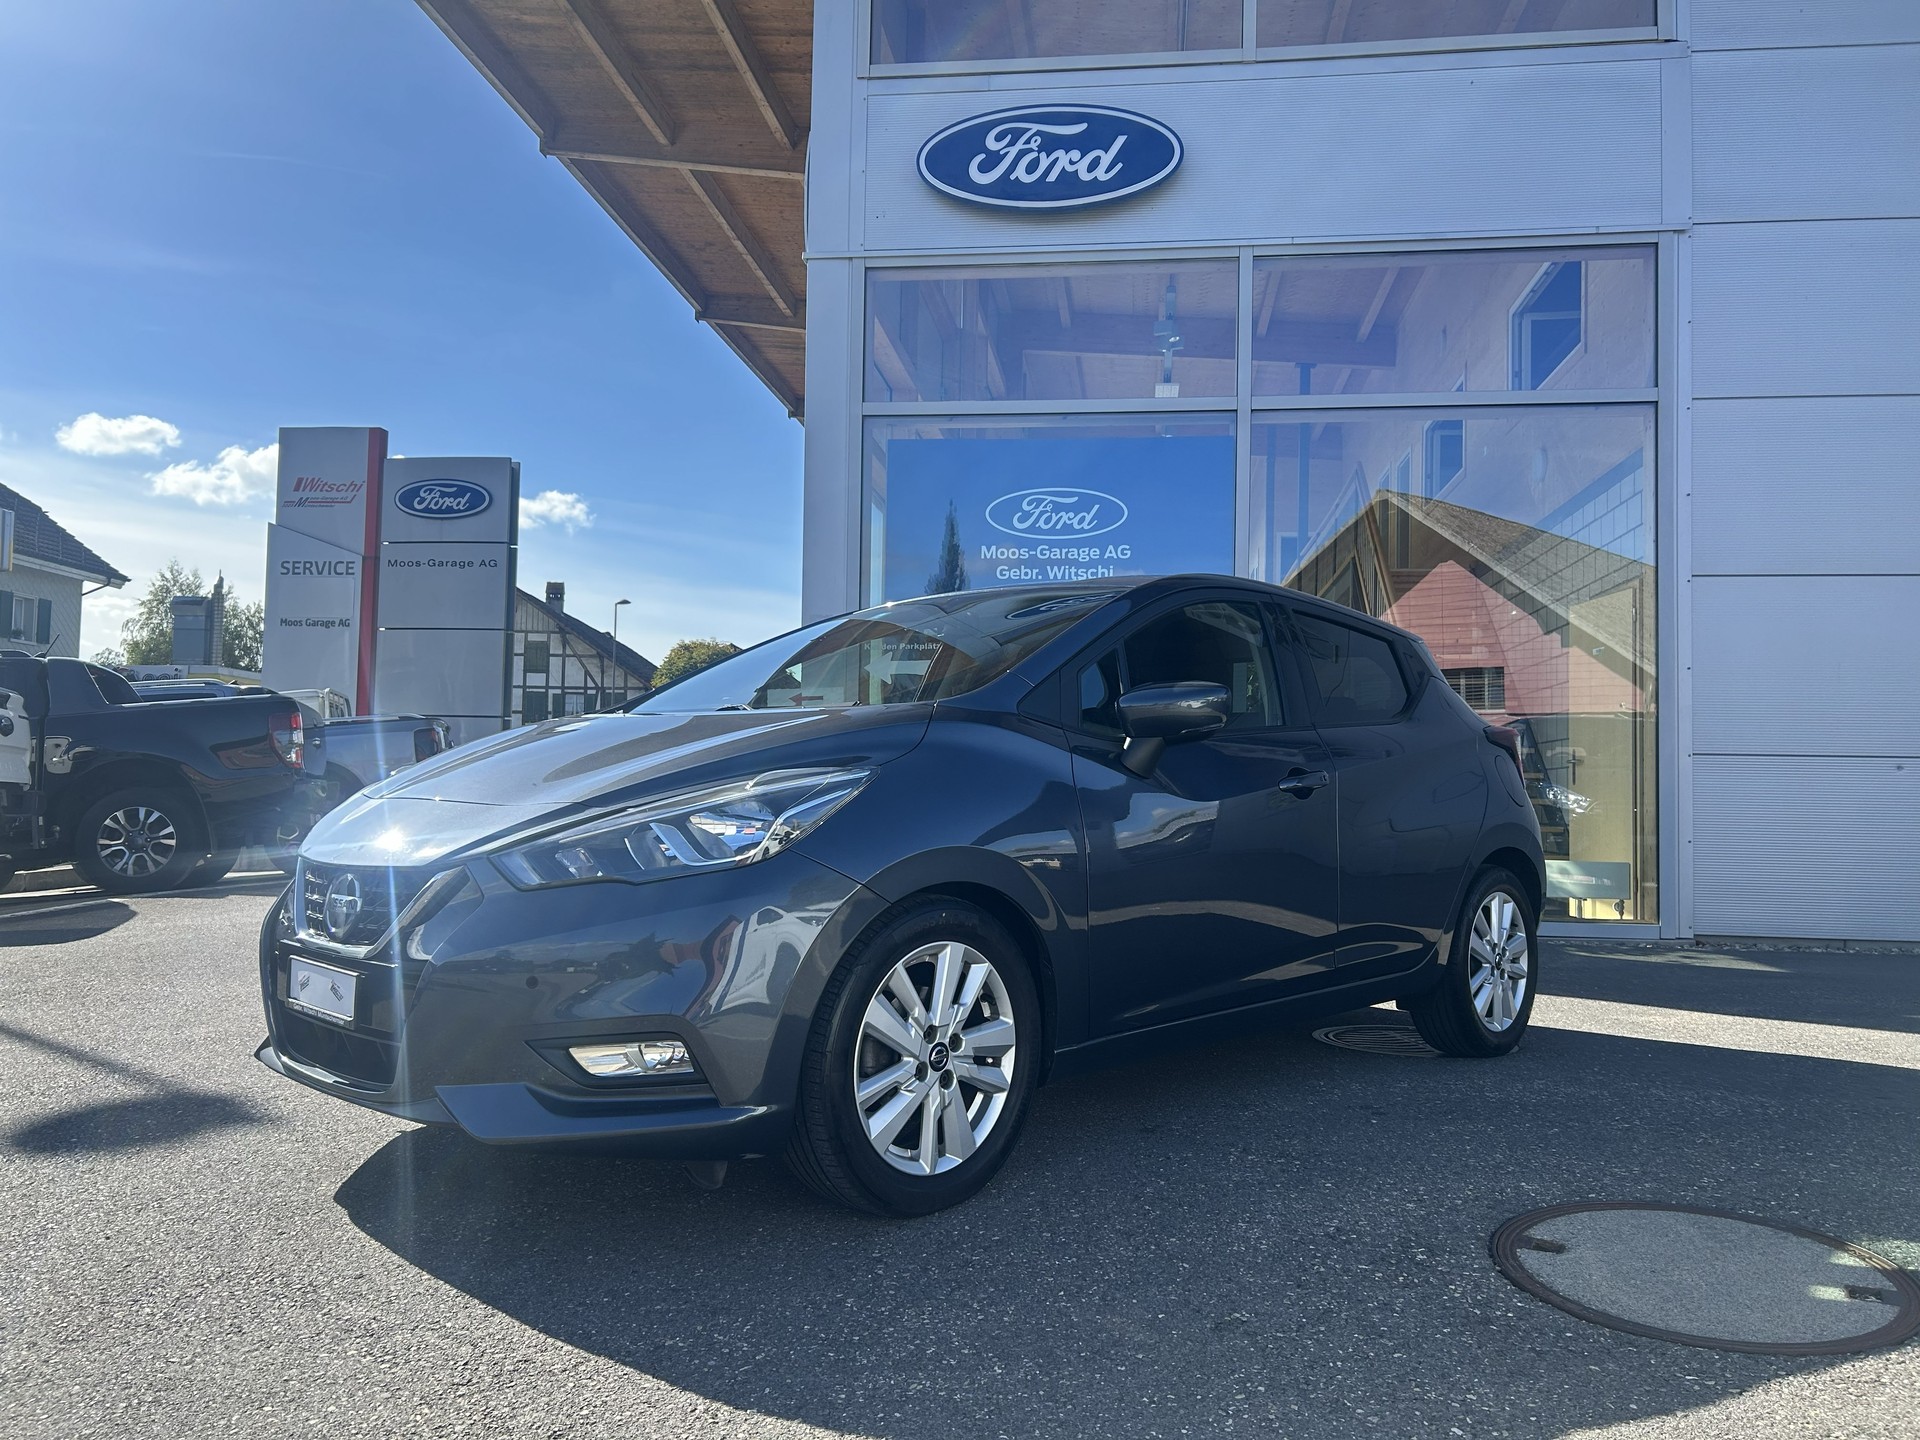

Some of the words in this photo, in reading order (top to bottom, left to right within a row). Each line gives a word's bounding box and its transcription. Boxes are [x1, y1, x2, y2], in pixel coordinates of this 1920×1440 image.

[969, 122, 1128, 184] Ford
[301, 477, 365, 492] Witschi
[414, 486, 471, 510] Ford
[1013, 495, 1100, 529] Ford
[981, 545, 1099, 561] Moos-Garage
[1104, 545, 1131, 559] AG
[280, 561, 356, 575] SERVICE
[387, 558, 474, 569] Moos-Garage
[479, 559, 498, 567] AG
[996, 566, 1042, 580] Gebr.
[1047, 566, 1114, 580] Witschi
[280, 618, 303, 627] Moos
[305, 618, 336, 629] Garage
[338, 618, 350, 627] AG
